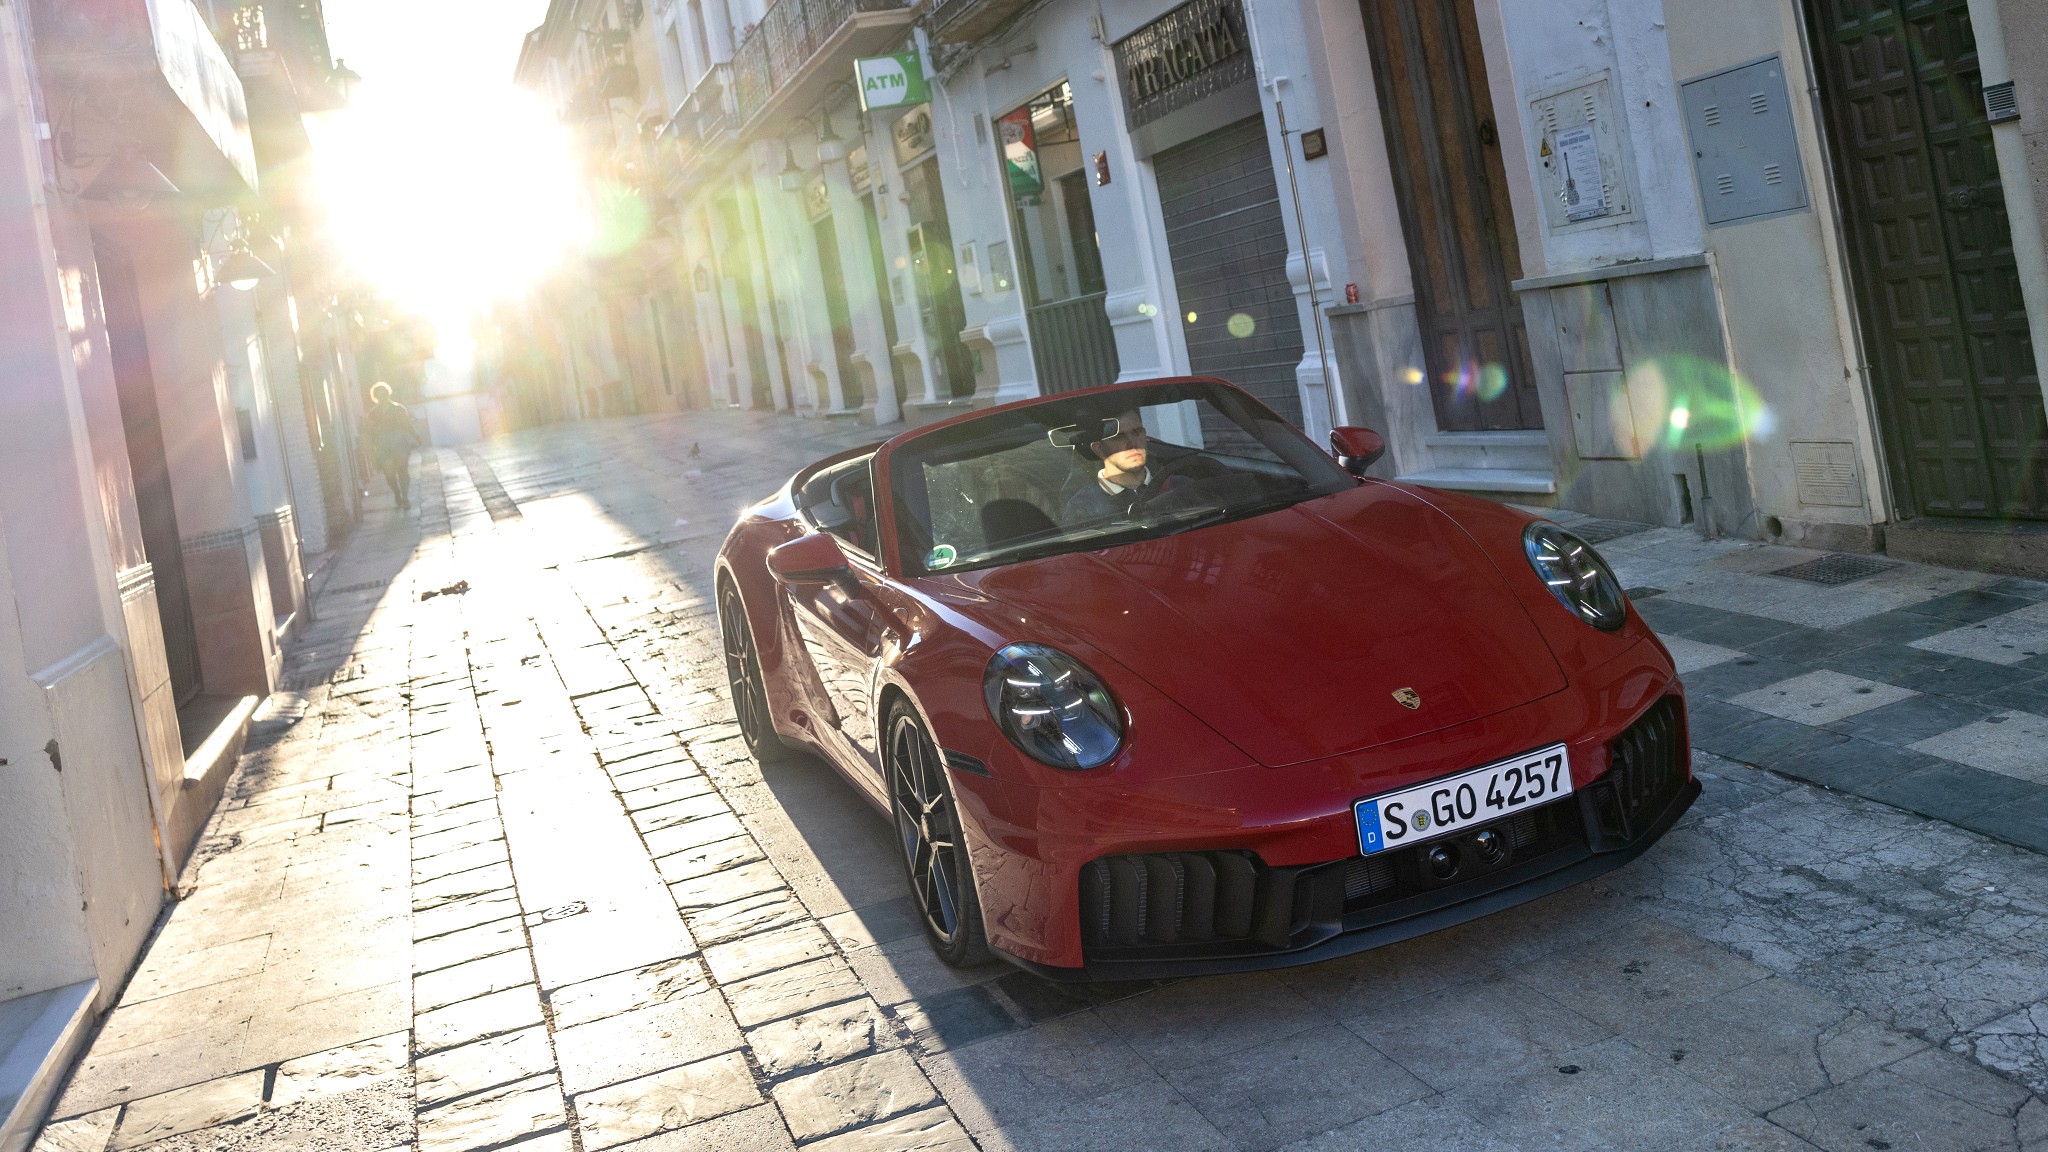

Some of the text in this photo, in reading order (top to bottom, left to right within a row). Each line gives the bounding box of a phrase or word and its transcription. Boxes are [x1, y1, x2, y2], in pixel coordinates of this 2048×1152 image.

[866, 72, 905, 91] ATM
[936, 549, 944, 558] 4
[1383, 802, 1408, 840] S
[1431, 783, 1477, 827] GO
[1485, 753, 1563, 810] 4257
[1367, 831, 1376, 844] D
